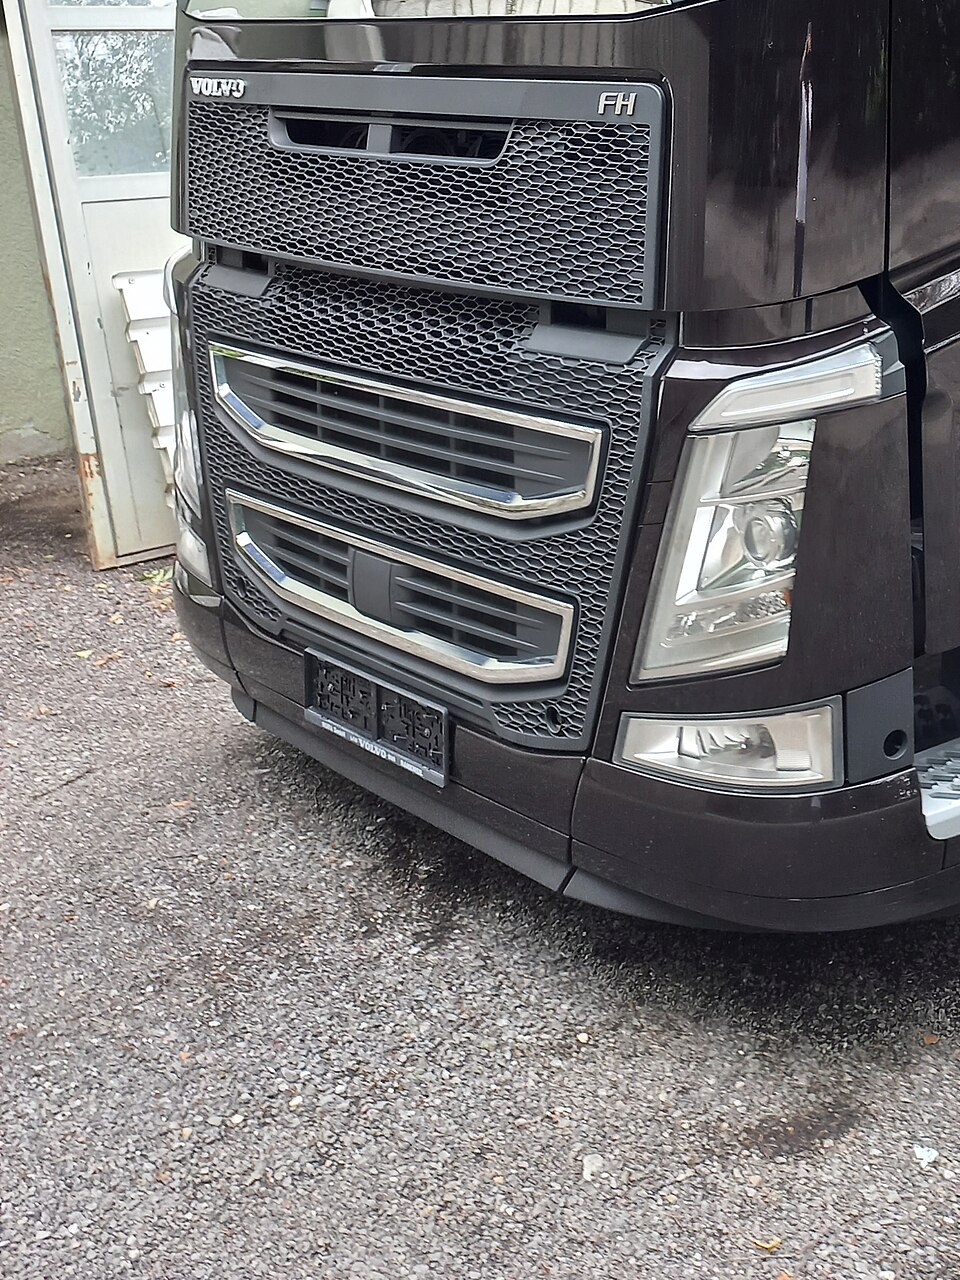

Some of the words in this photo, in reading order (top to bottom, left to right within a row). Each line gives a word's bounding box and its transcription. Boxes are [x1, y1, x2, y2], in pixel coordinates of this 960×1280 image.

[190, 77, 246, 99] VOLVO
[597, 91, 638, 116] FH
[359, 738, 387, 760] VOLVO
